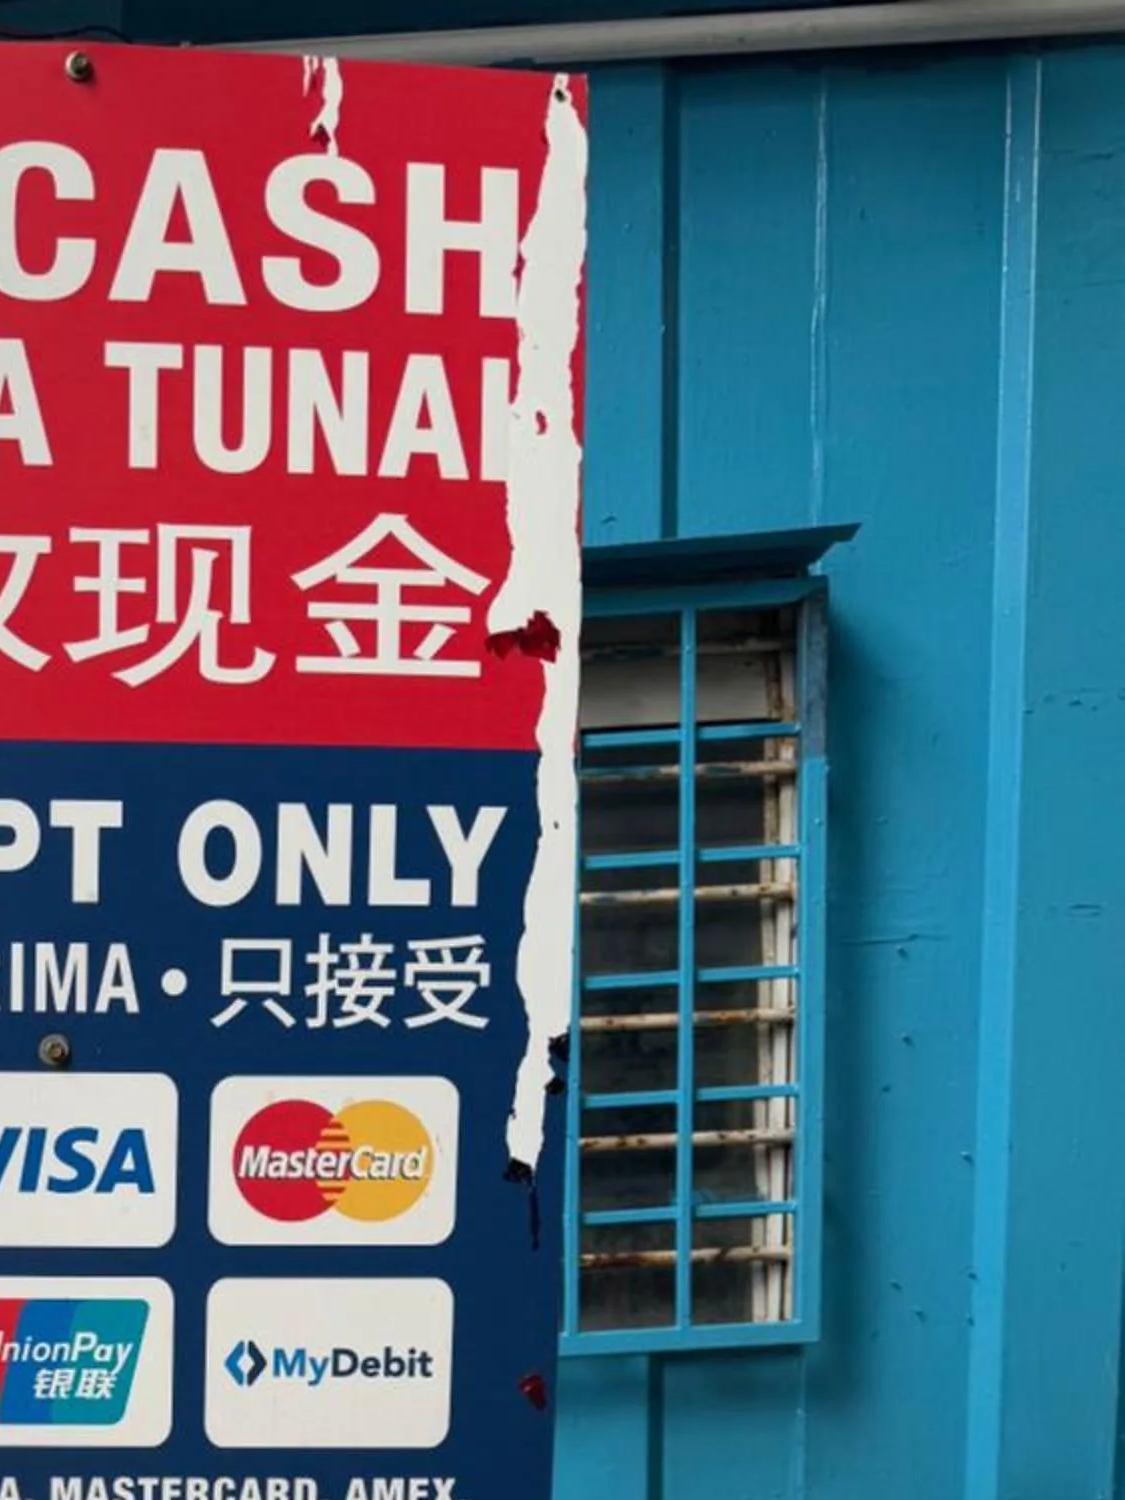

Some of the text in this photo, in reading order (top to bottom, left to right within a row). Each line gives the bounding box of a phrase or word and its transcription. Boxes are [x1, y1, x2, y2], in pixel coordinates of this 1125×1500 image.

[177, 799, 508, 907] ONLY
[210, 932, 491, 1029] 只接受
[237, 1144, 425, 1180] MasterCard
[32, 1368, 115, 1400] 银联
[272, 1347, 434, 1387] MyDebit
